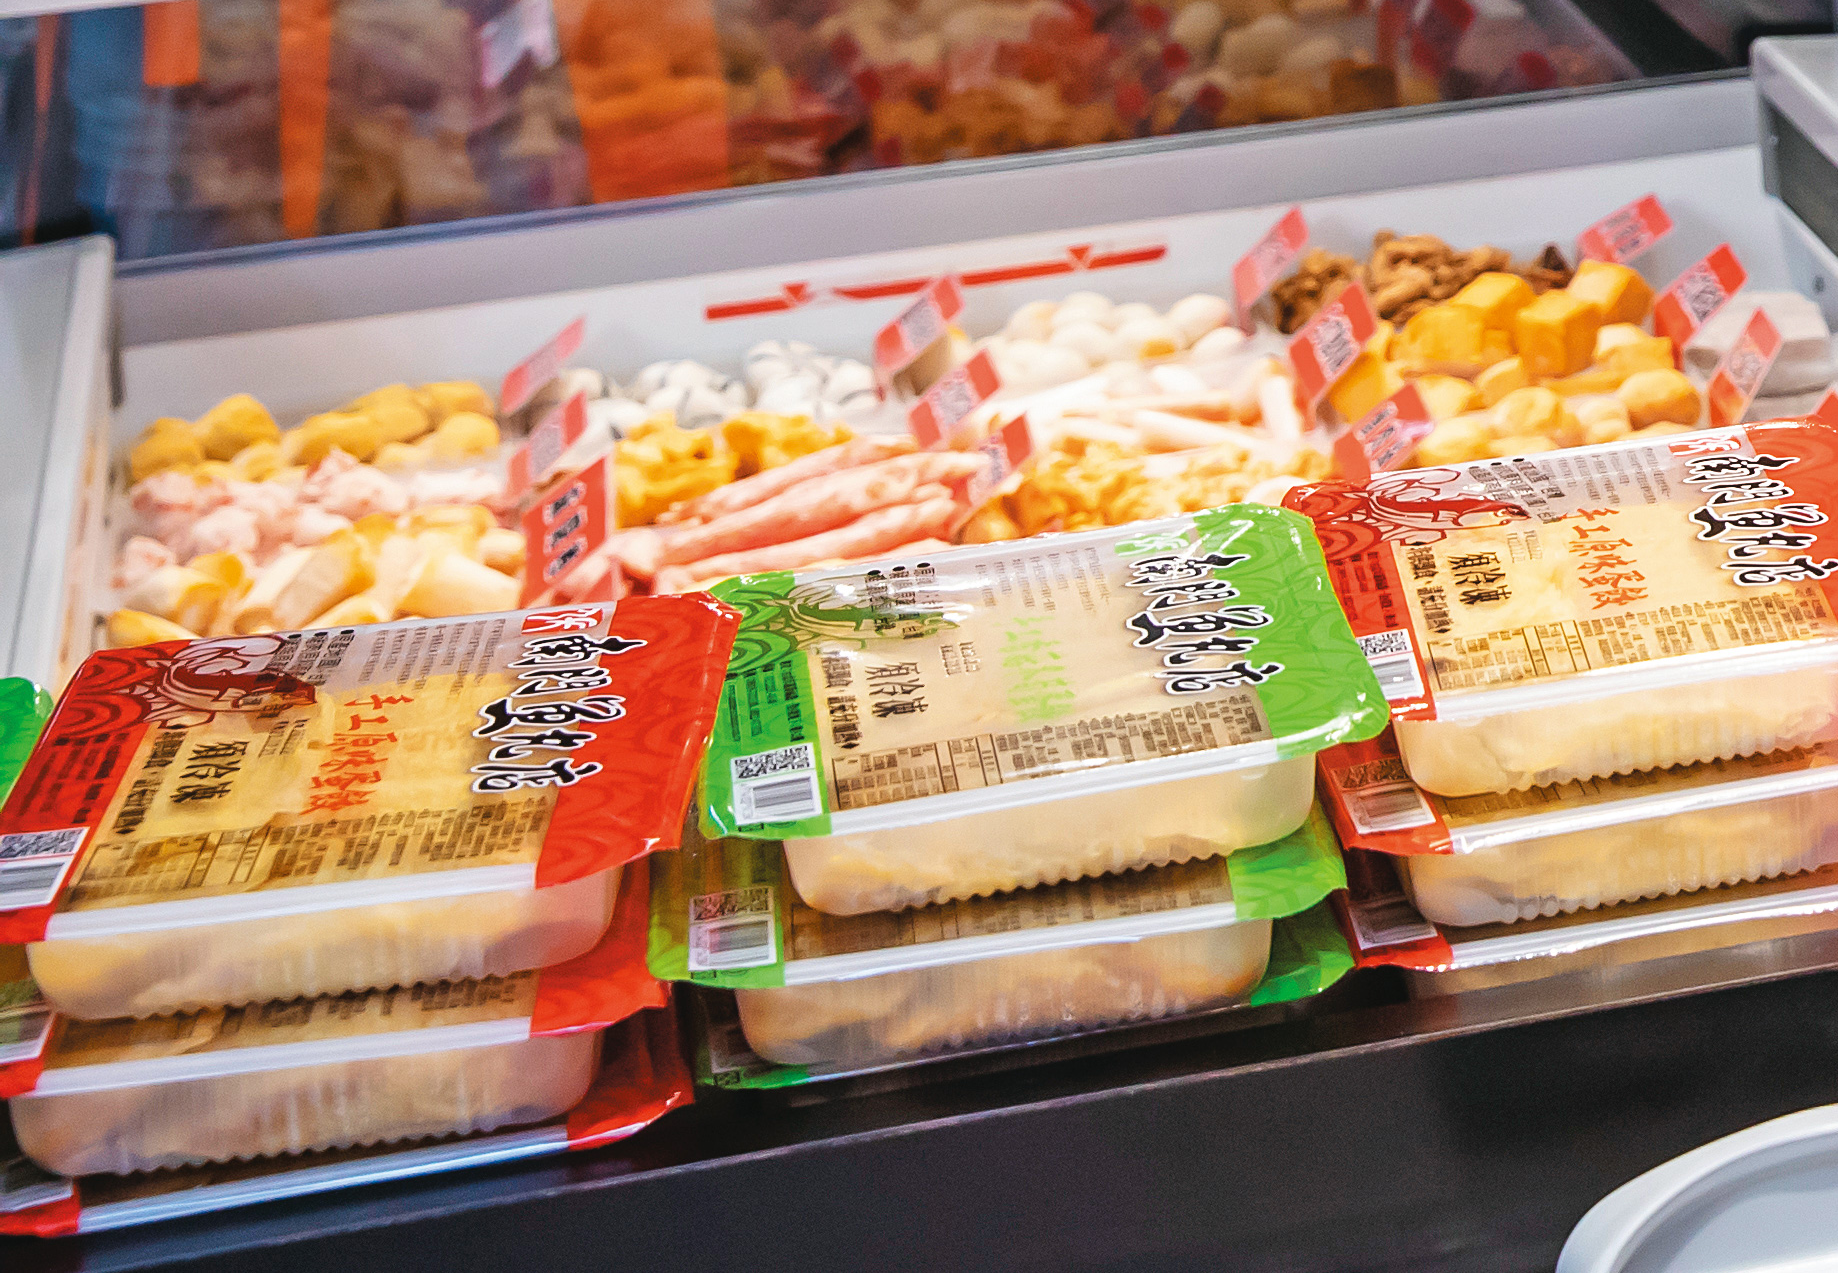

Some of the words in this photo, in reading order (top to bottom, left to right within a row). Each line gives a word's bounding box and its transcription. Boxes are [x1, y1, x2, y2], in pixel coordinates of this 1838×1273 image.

[1449, 549, 1515, 607] 須冷凍
[1567, 503, 1652, 613] 手工原味蛋餃
[1126, 551, 1287, 696] 南門魚丸店
[472, 634, 649, 794] 南門魚丸店
[862, 663, 932, 721] 須冷凍
[168, 741, 251, 807] 須冷凍
[299, 692, 417, 817] 手工原味蛋餃
